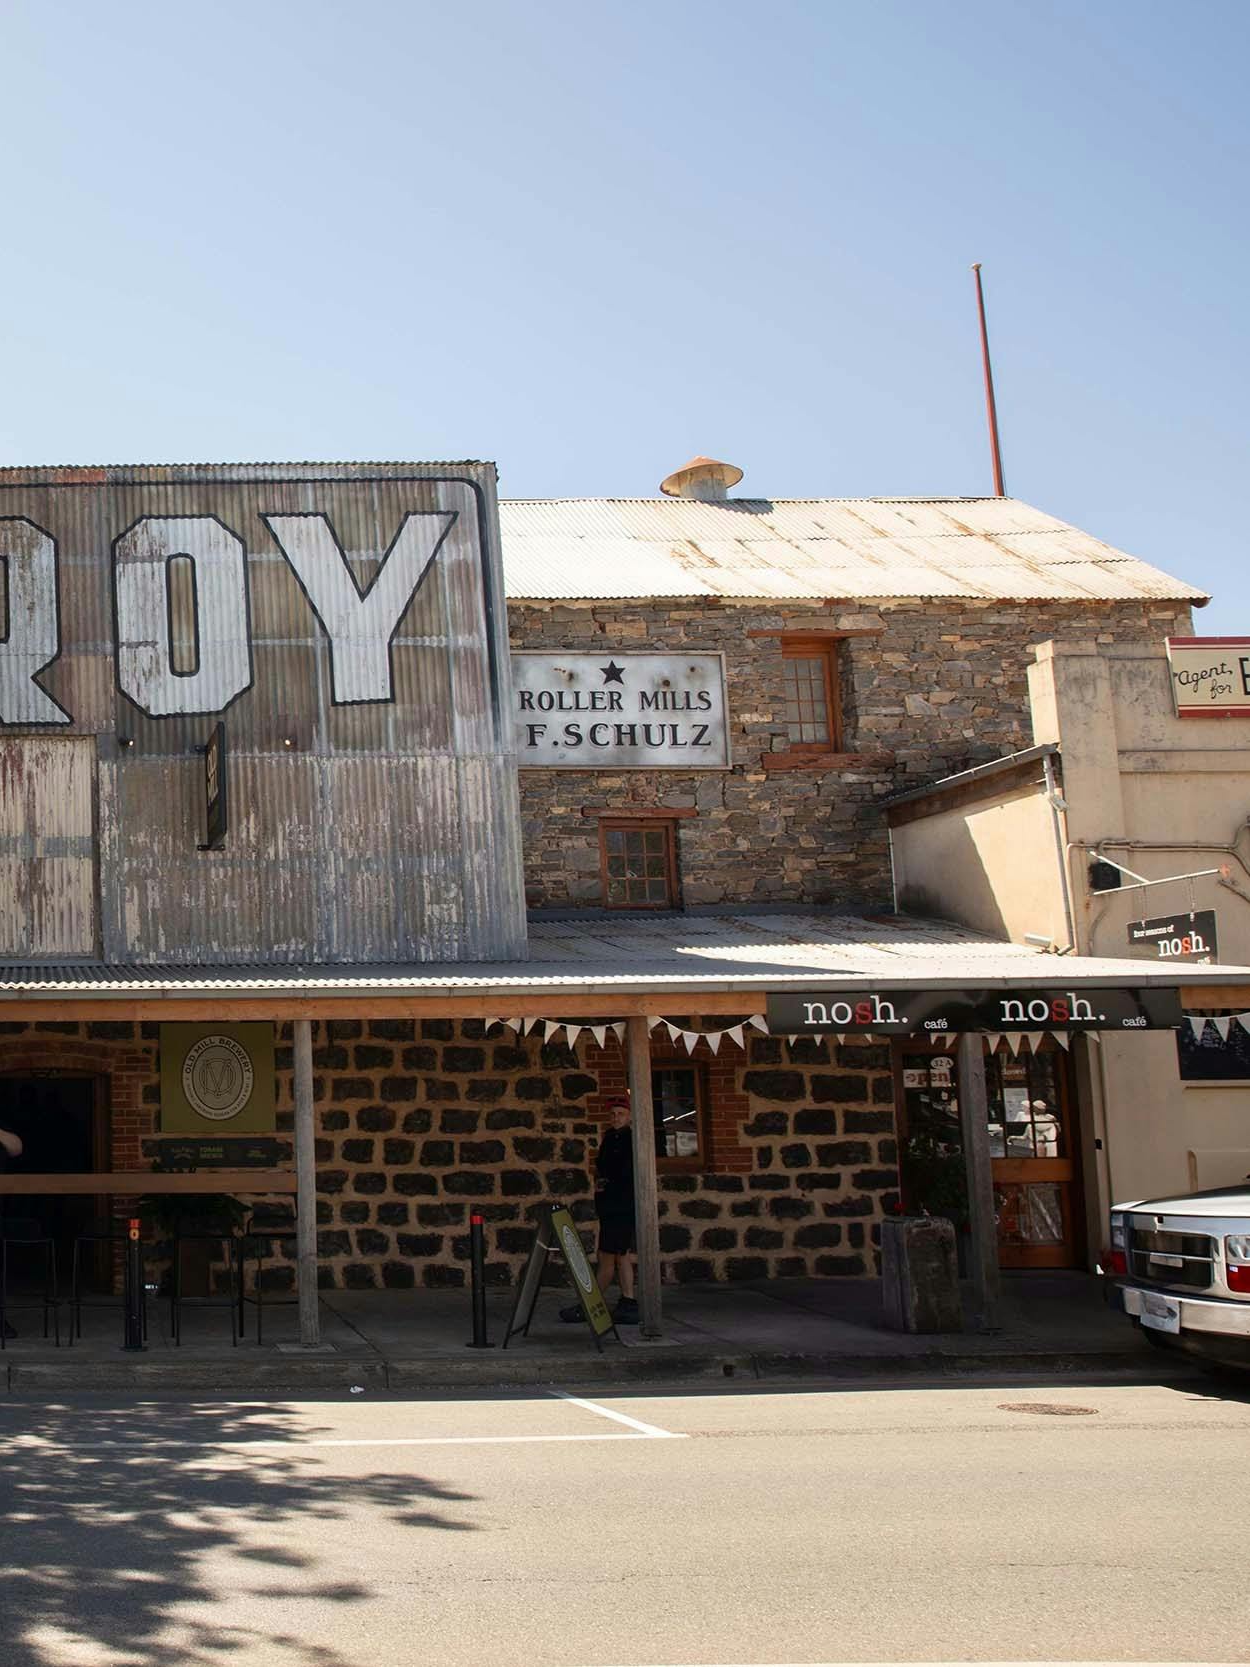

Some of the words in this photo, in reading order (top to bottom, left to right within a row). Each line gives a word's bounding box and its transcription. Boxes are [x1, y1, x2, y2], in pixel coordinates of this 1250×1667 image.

[1177, 662, 1232, 693] Agent
[1210, 679, 1232, 699] for
[518, 690, 623, 711] ROLLER
[639, 690, 712, 711] MILLS
[1157, 931, 1210, 957] nosh.
[803, 995, 908, 1025] nosh.
[924, 1018, 948, 1029] café
[1000, 992, 1106, 1023] nosh.
[1122, 1016, 1147, 1027] café
[185, 1055, 196, 1074] OLD
[194, 1039, 215, 1054] MILL
[218, 1038, 252, 1074] BREWERY
